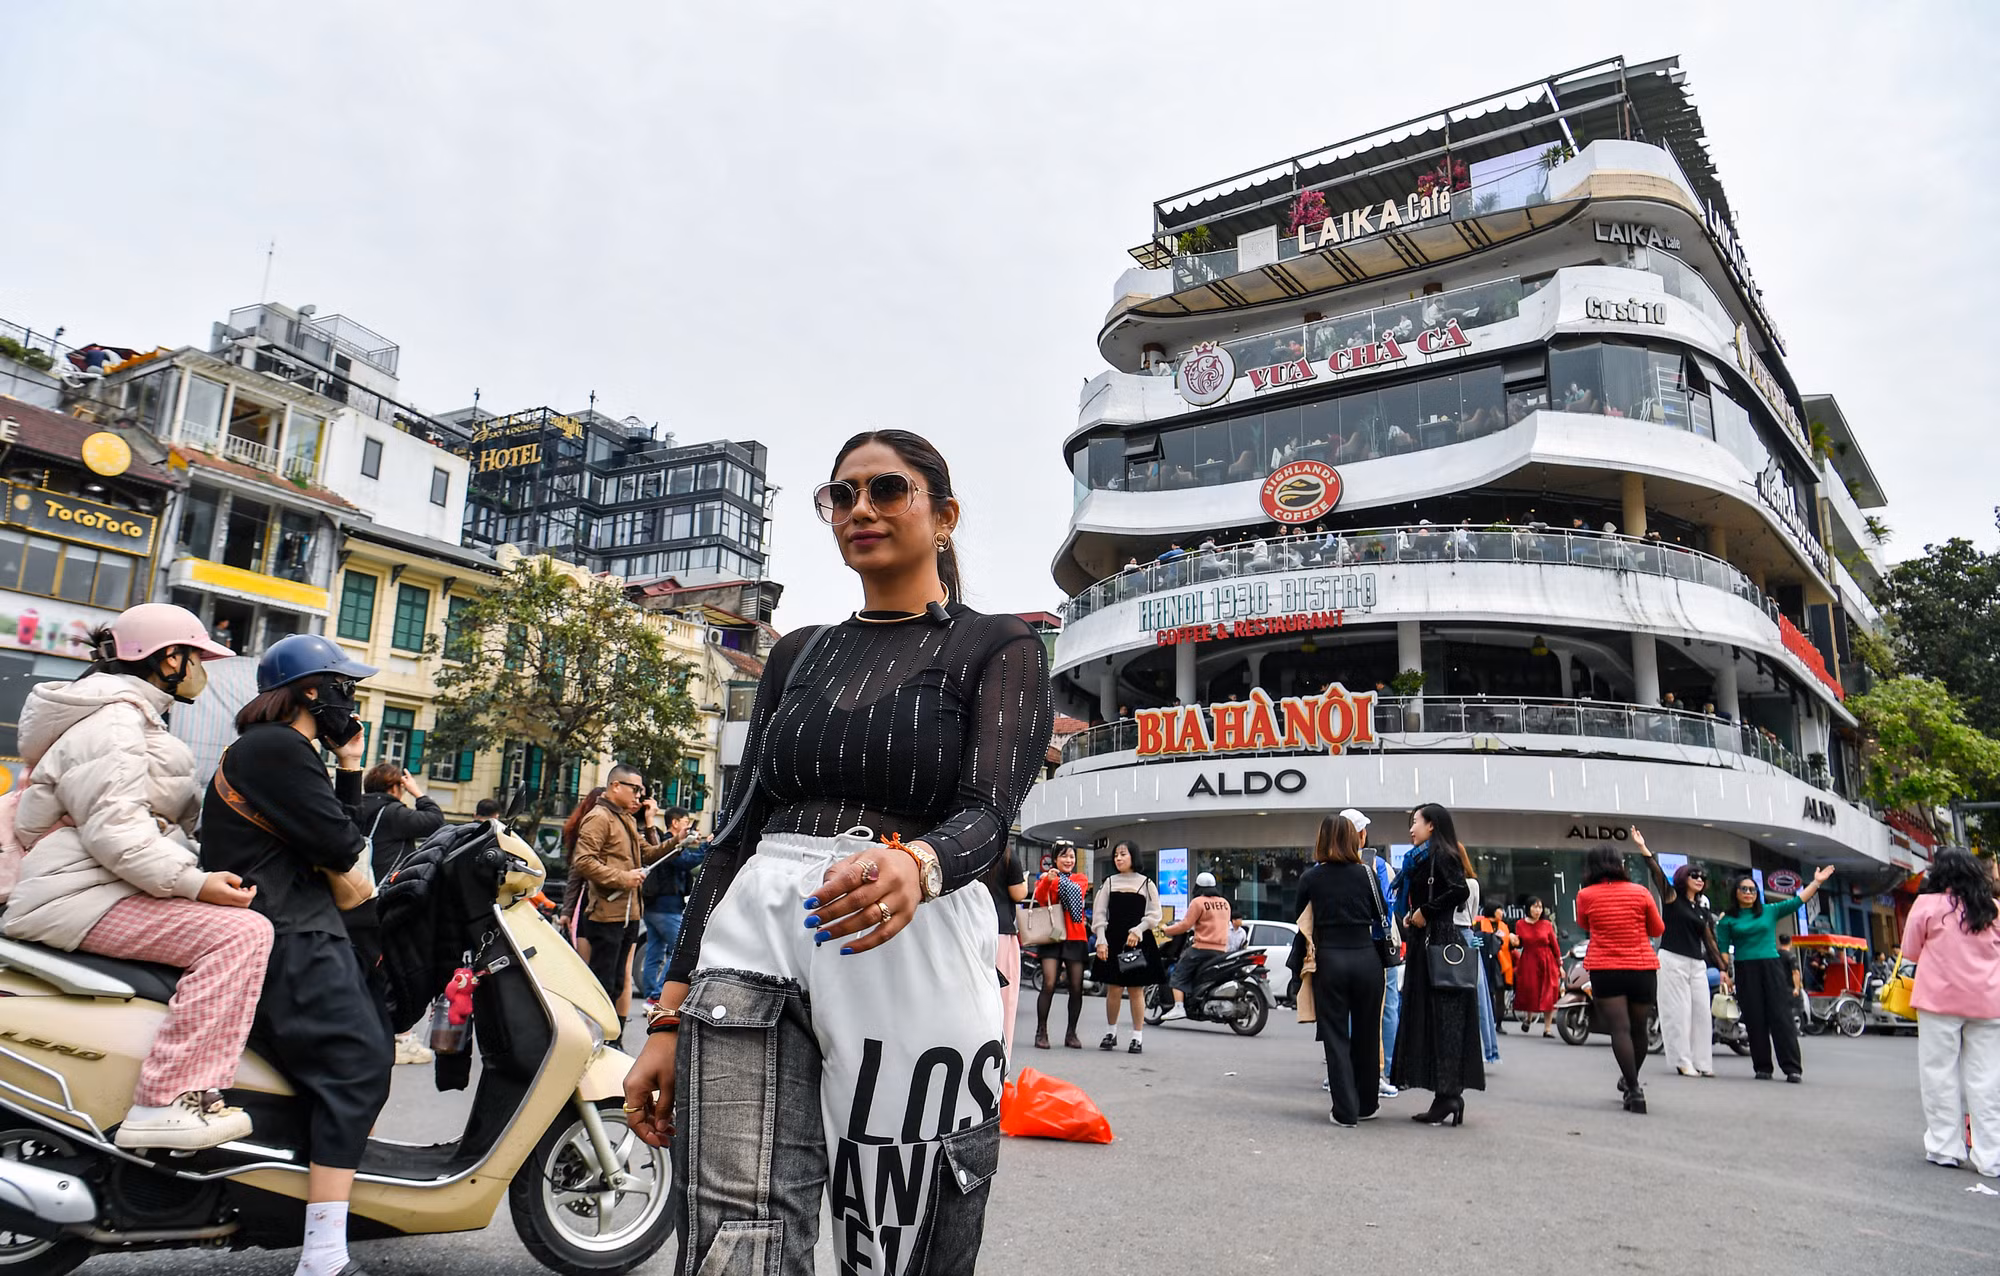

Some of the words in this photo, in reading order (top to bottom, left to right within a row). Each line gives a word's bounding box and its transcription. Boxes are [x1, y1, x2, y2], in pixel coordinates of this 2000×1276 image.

[1298, 198, 1403, 252] LAIKA
[1407, 185, 1451, 222] Café
[1592, 220, 1663, 248] LAIKA
[1643, 302, 1667, 325] 10
[1245, 356, 1317, 391] VUA
[1328, 330, 1407, 373] CHẢ
[1416, 317, 1472, 354] CÁ
[479, 442, 541, 472] HOTEL
[1264, 464, 1336, 495] HIGHLANDS
[1274, 500, 1329, 520] COFFEE
[1760, 472, 1807, 544] HIGHLANDS
[1138, 590, 1204, 632] HANOI
[1210, 581, 1269, 621] 1930
[1280, 572, 1377, 613] BISTRO
[1156, 625, 1212, 647] COFFEE
[1216, 625, 1229, 640] &
[1234, 609, 1345, 638] RESTAURANT
[1136, 706, 1209, 757] BIA
[1211, 689, 1279, 752] HÀ
[1282, 685, 1375, 756] NỘI
[1187, 769, 1307, 798] ALDO
[1802, 796, 1837, 825] ALDO
[1567, 825, 1628, 841] ALDO
